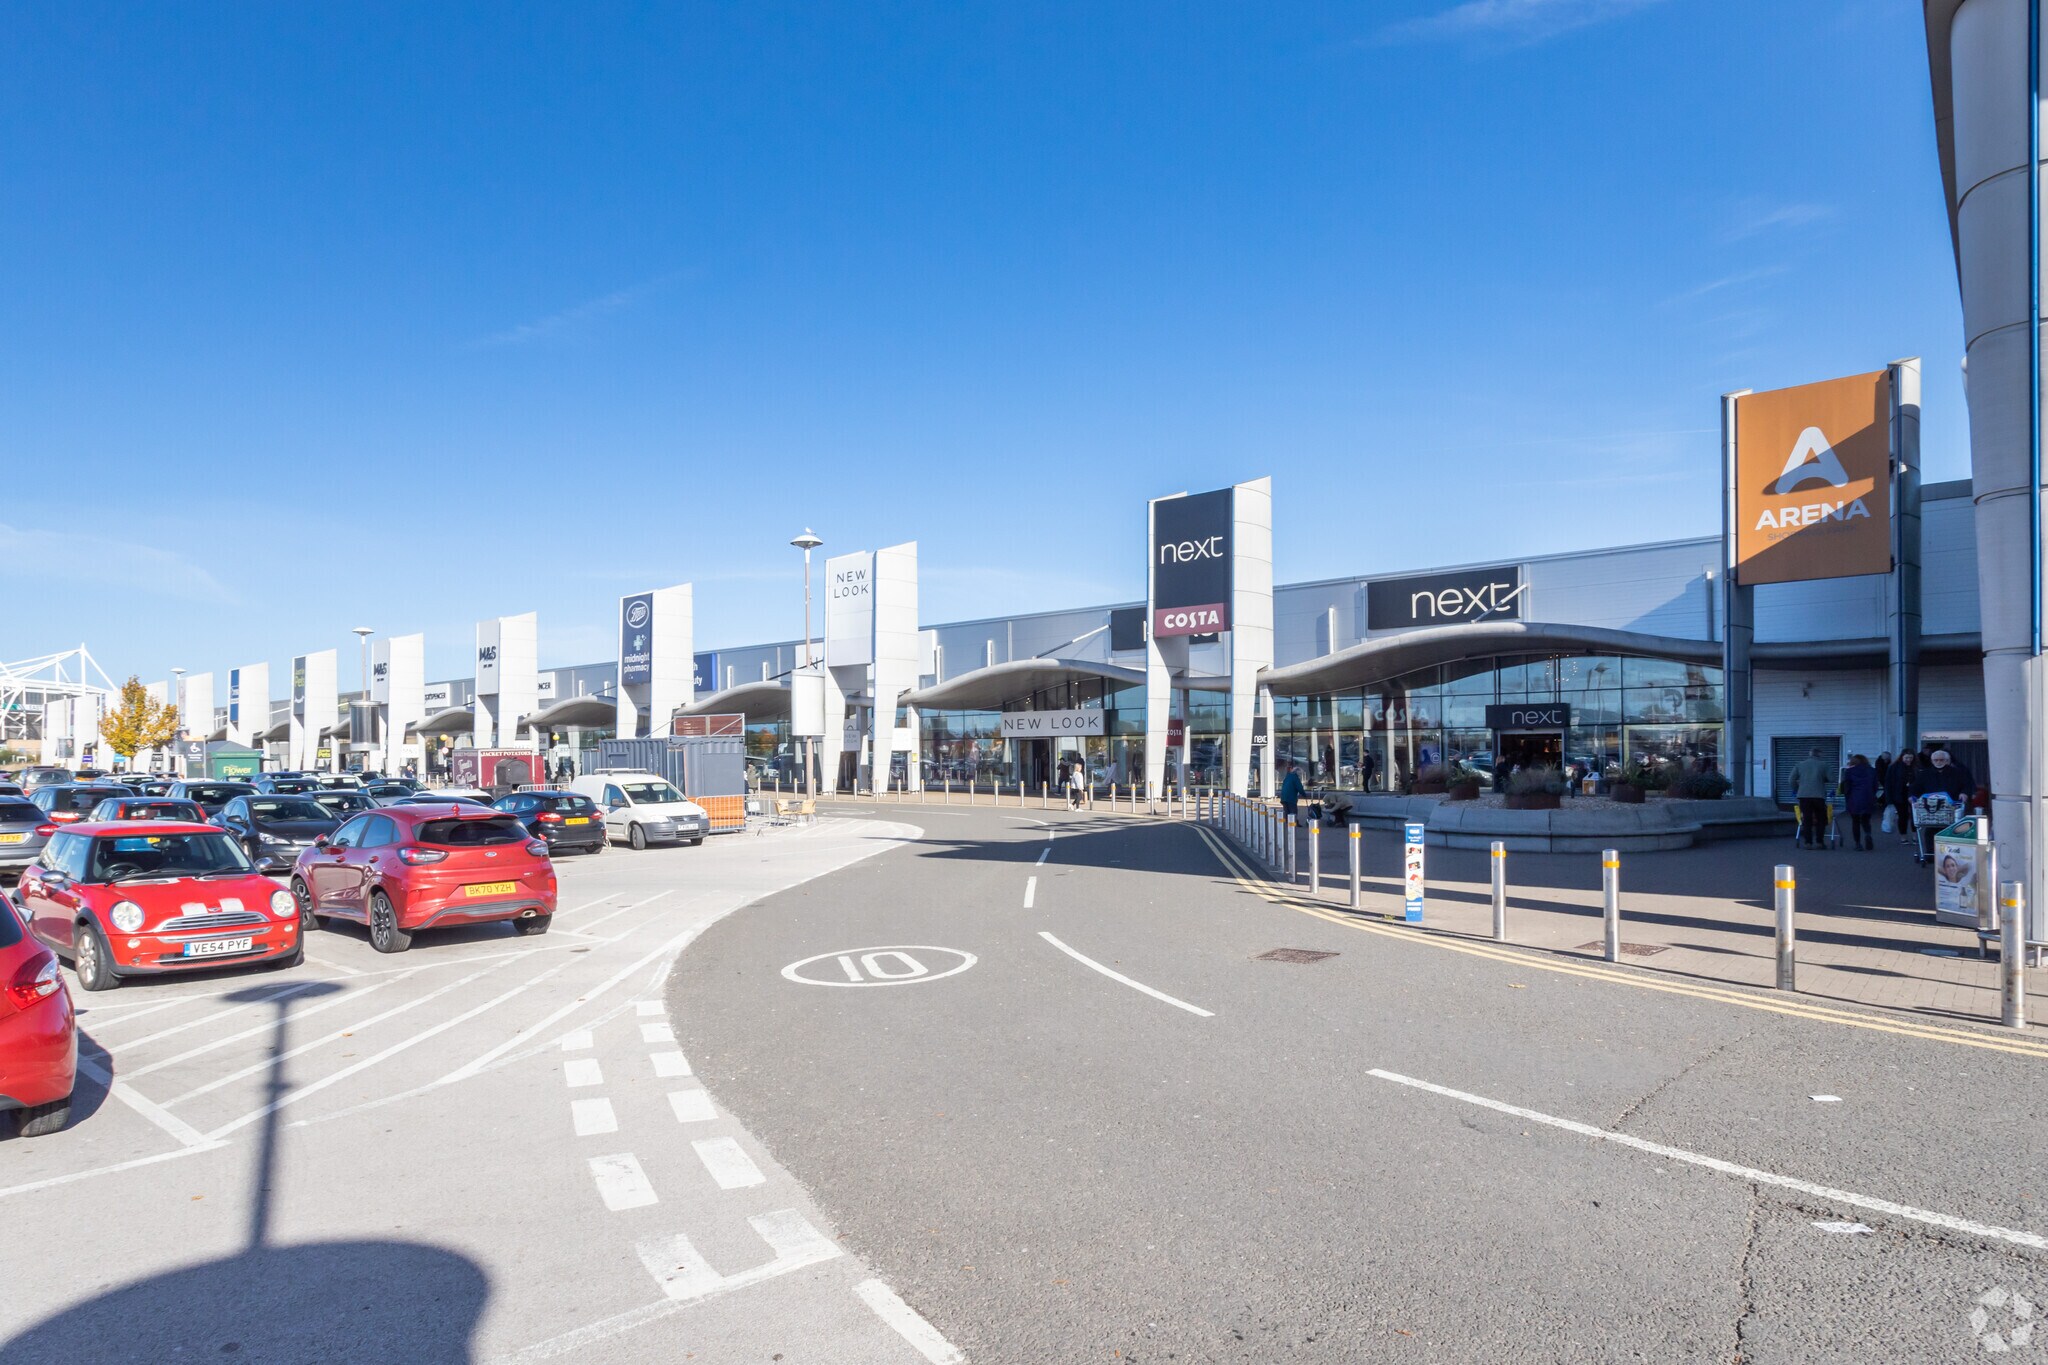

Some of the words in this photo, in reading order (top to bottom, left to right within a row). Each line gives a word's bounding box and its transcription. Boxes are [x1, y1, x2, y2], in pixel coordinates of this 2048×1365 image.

[1754, 498, 1871, 531] ARENA
[1161, 536, 1223, 564] next
[836, 569, 866, 583] NEW
[834, 584, 869, 598] LOOK
[1411, 582, 1511, 619] next
[1164, 610, 1219, 628] COSTA
[479, 646, 496, 662] M&S
[624, 653, 650, 664] midnight
[373, 662, 387, 676] M&S
[624, 664, 650, 674] pharmacy
[1004, 718, 1042, 730] NEW
[1051, 716, 1099, 729] LOOK
[1512, 710, 1562, 724] next
[223, 765, 252, 774] Flower
[469, 885, 493, 895] BK70
[494, 884, 512, 893] YZH
[193, 942, 224, 953] VE54
[228, 939, 250, 950] PYF
[837, 951, 929, 982] 10
